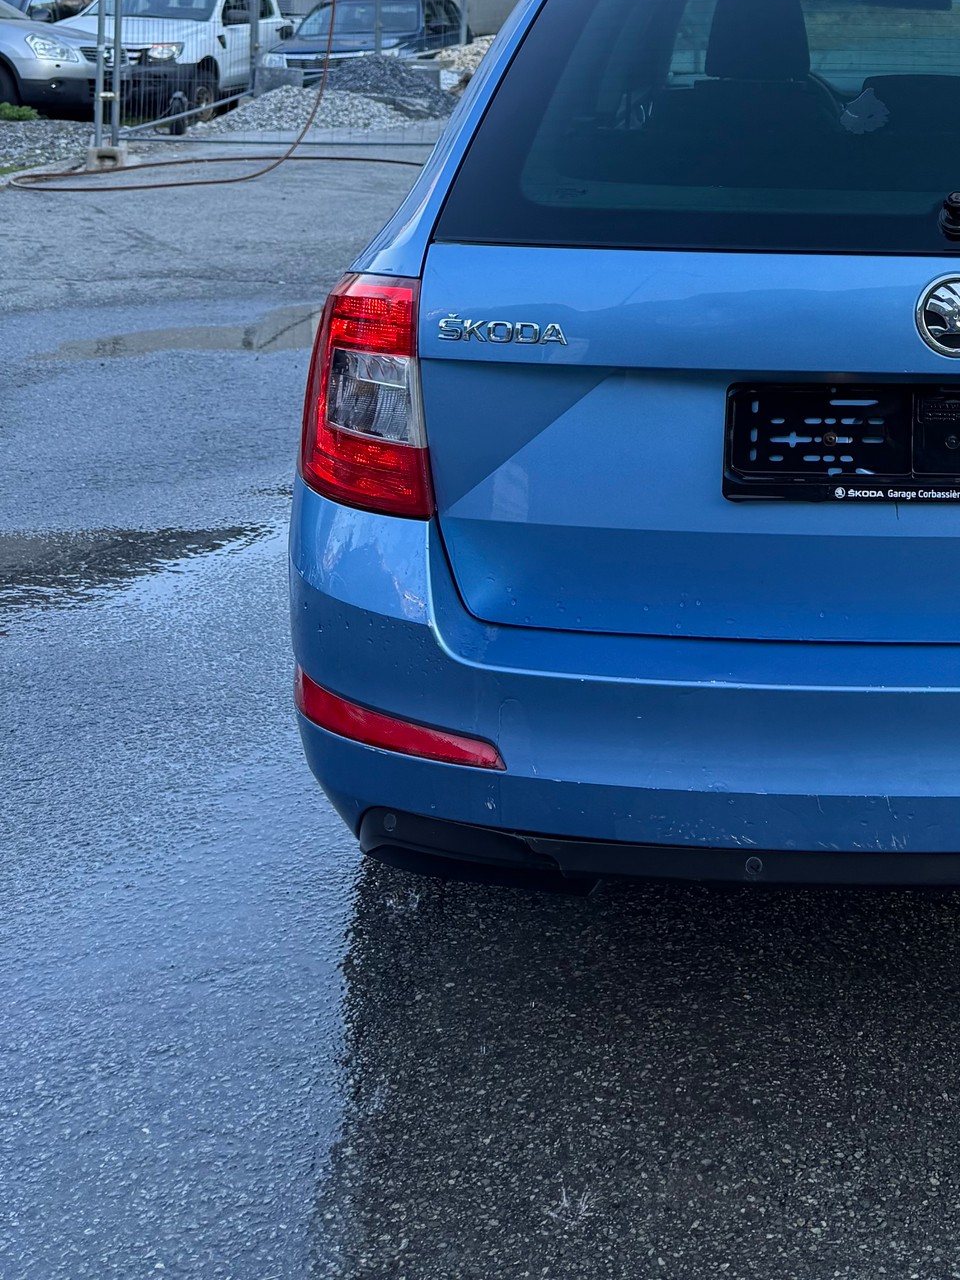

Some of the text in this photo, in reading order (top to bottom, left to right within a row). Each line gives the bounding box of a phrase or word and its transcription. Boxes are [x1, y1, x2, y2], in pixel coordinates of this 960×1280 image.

[438, 314, 568, 345] ŠKODA
[847, 488, 885, 498] ŠKODA
[887, 489, 917, 500] Garage
